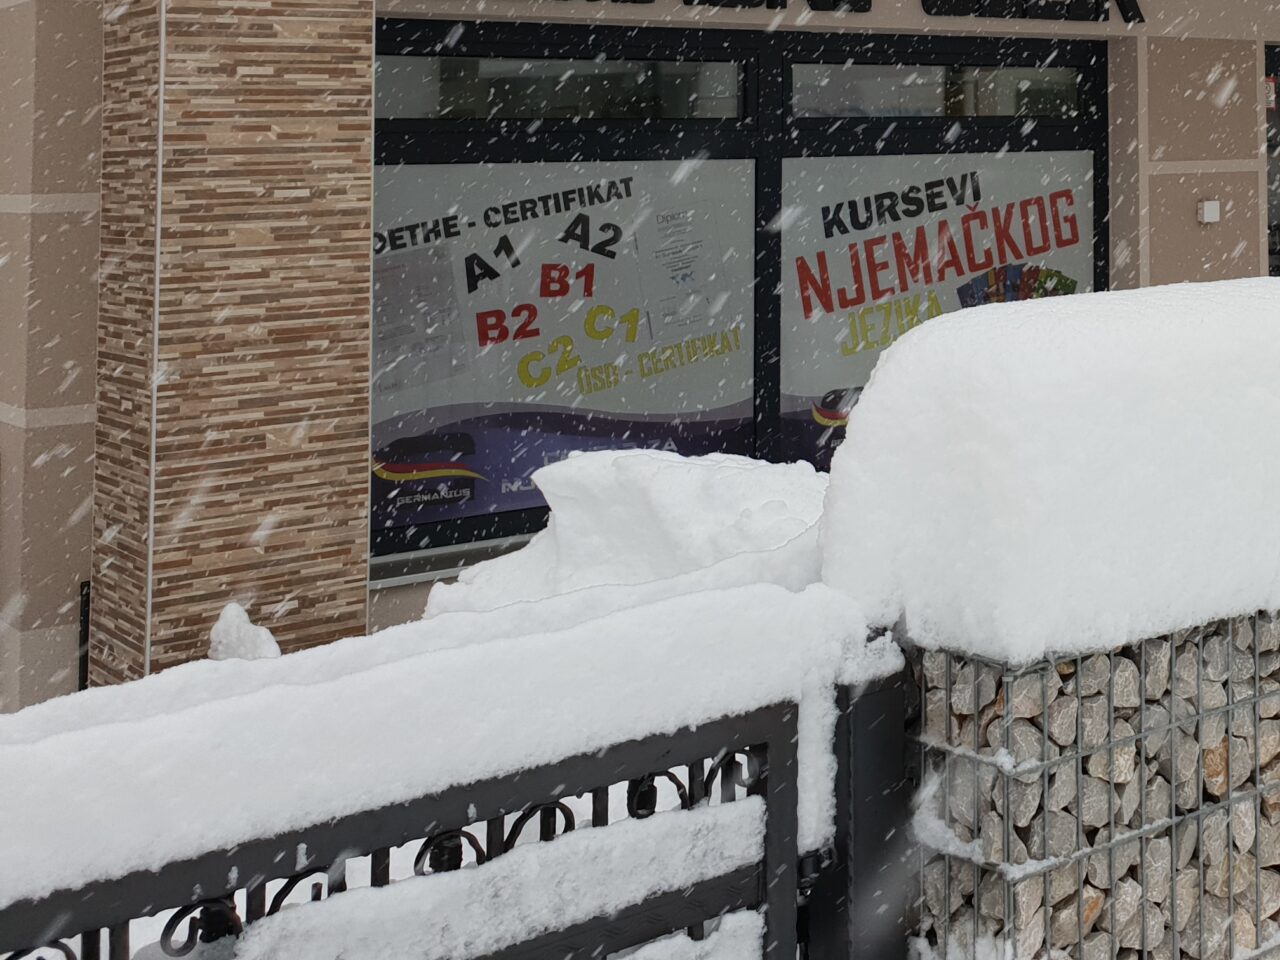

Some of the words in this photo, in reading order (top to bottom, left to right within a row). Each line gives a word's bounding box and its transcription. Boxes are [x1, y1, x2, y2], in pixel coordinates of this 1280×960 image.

[483, 176, 634, 229] CERTIFIKAT
[821, 171, 982, 239] KURSEVI
[558, 213, 624, 260] A2
[795, 188, 1080, 320] NJEMAČKOG
[463, 234, 522, 294] A1
[539, 263, 596, 298] B1
[476, 303, 541, 347] B2
[583, 305, 641, 344] C1
[516, 334, 583, 389] C2
[637, 325, 742, 380] CERTIFIKAT
